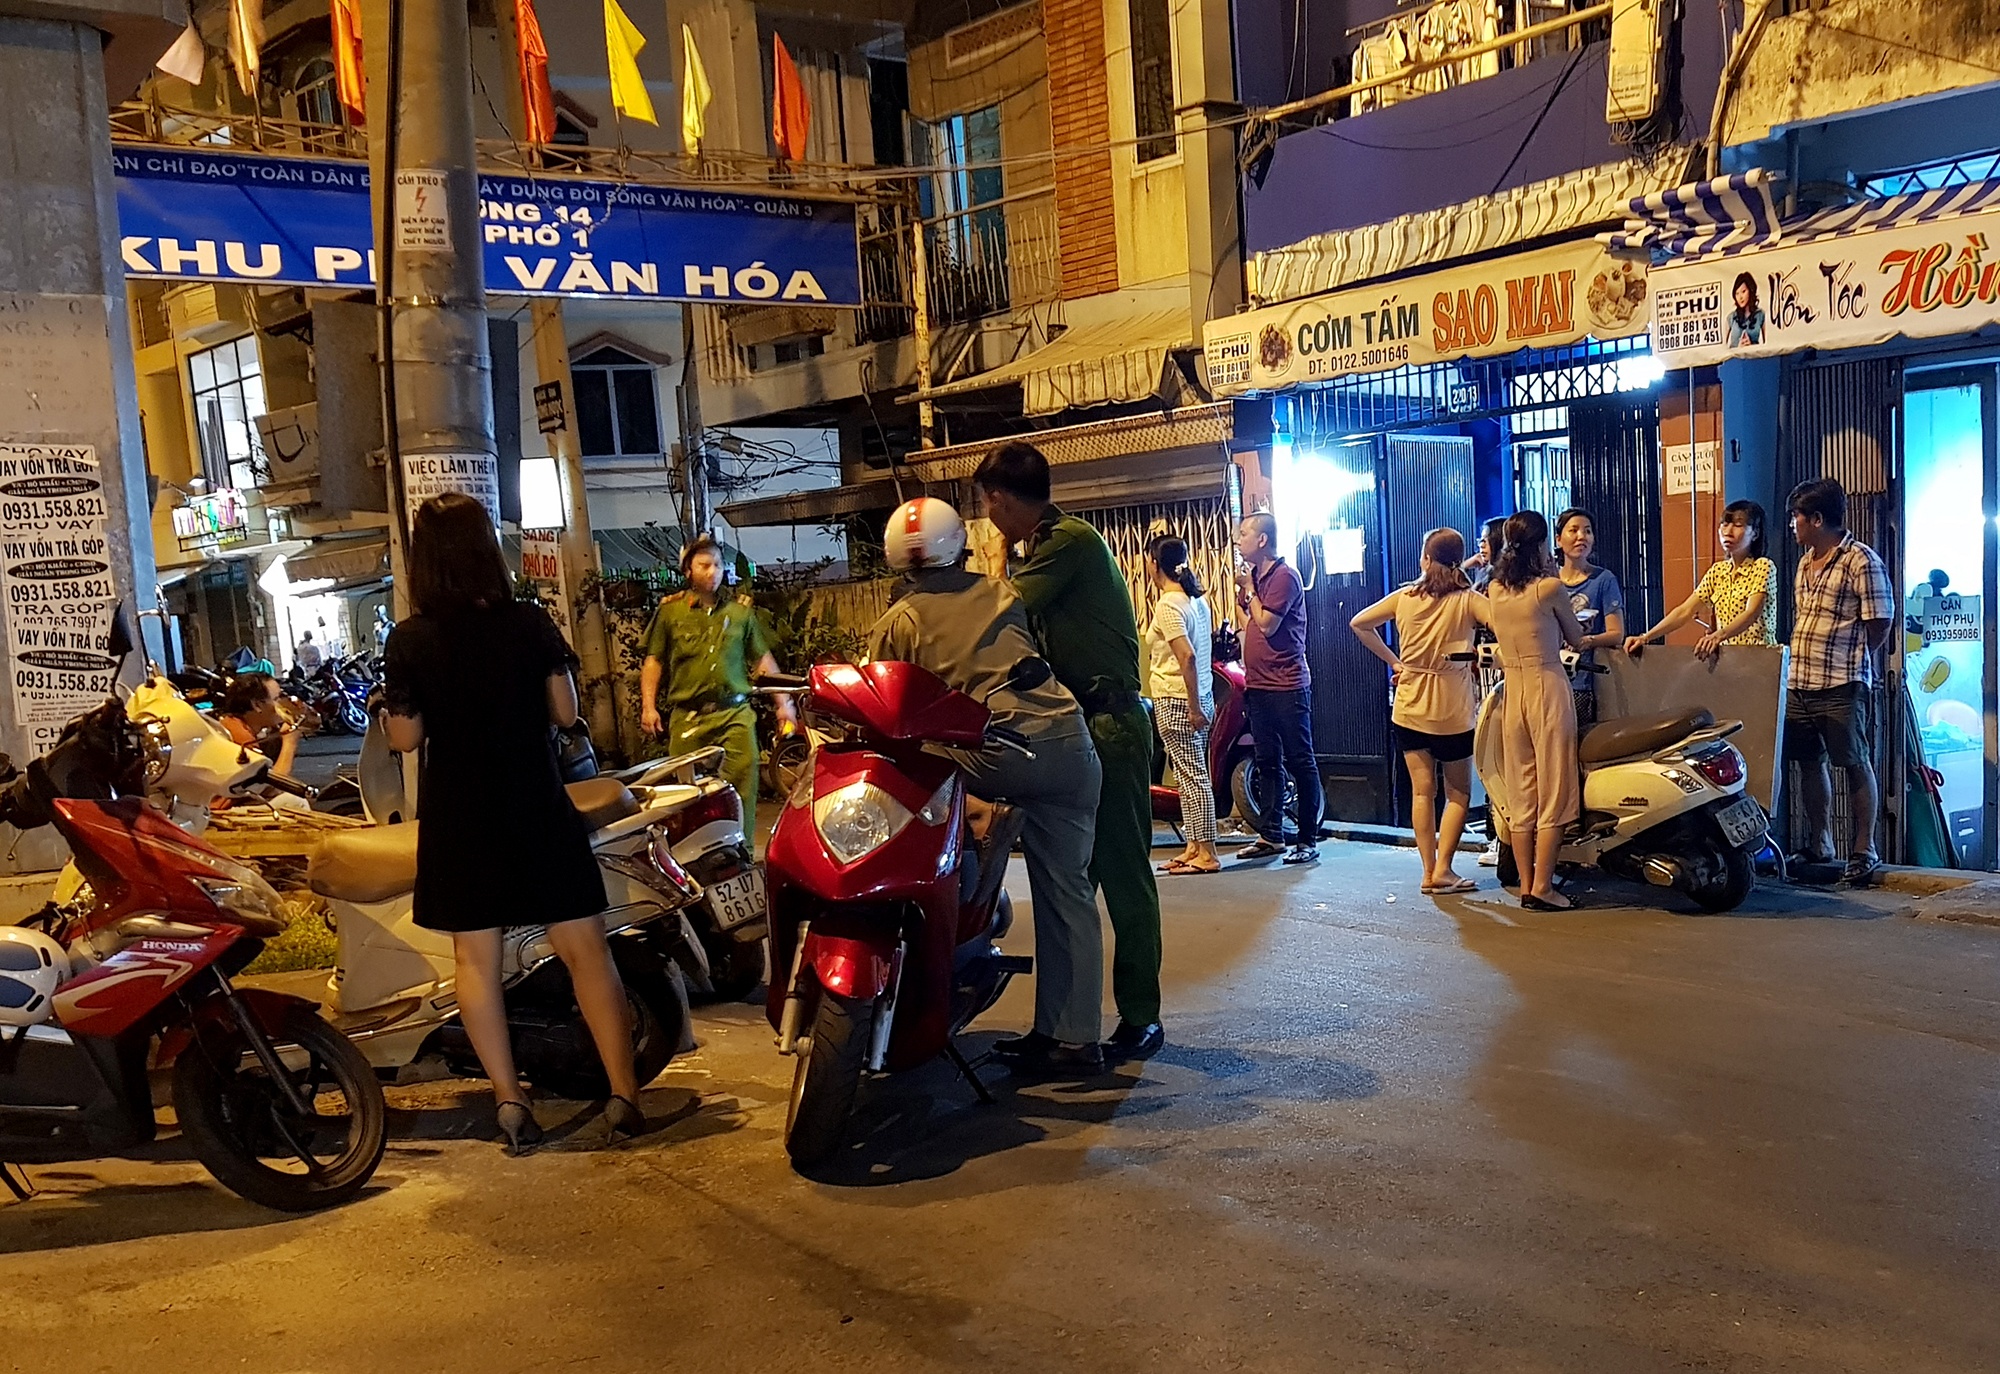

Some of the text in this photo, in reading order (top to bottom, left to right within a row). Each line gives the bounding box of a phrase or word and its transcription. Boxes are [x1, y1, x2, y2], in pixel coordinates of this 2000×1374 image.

[112, 156, 140, 170] AN
[311, 168, 354, 186] DÂN
[480, 179, 505, 195] ÂY
[569, 185, 600, 201] ĐỜI
[660, 193, 696, 208] VĂN
[754, 200, 800, 217] QUẬN
[803, 206, 813, 217] 3
[555, 206, 592, 226] 14
[485, 221, 588, 248] PHỐ 1
[121, 236, 281, 278] KHU
[504, 252, 659, 294] VĂN
[684, 261, 828, 300] HÓA
[1298, 269, 1576, 356] CƠM TẤM SAO MAI
[1675, 291, 1719, 315] PHÚ
[1660, 323, 1679, 337] 0961
[1683, 320, 1699, 333] 861
[1702, 317, 1719, 330] 878
[1221, 340, 1250, 359] PHÚ
[1660, 330, 1719, 349] 0908 064 451
[1309, 344, 1409, 375] ĐT: 0122.5001646
[441, 455, 468, 474] LÀM
[3, 498, 104, 521] 0931.558.821
[56, 519, 94, 530] VAY
[4, 542, 26, 559] VAY
[29, 536, 53, 558] VỐN
[82, 534, 105, 555] GÓP
[542, 548, 557, 578] BÒ
[11, 580, 112, 602] 0931.558.821
[1954, 613, 1975, 627] PHỤ
[18, 629, 39, 645] VAY
[43, 627, 66, 647] VỐN
[95, 631, 110, 651] GÓ
[1925, 627, 1979, 641] 0933959086
[17, 670, 108, 693] 0931.558.82
[724, 892, 765, 922] 8616
[142, 941, 201, 951] HONDA
